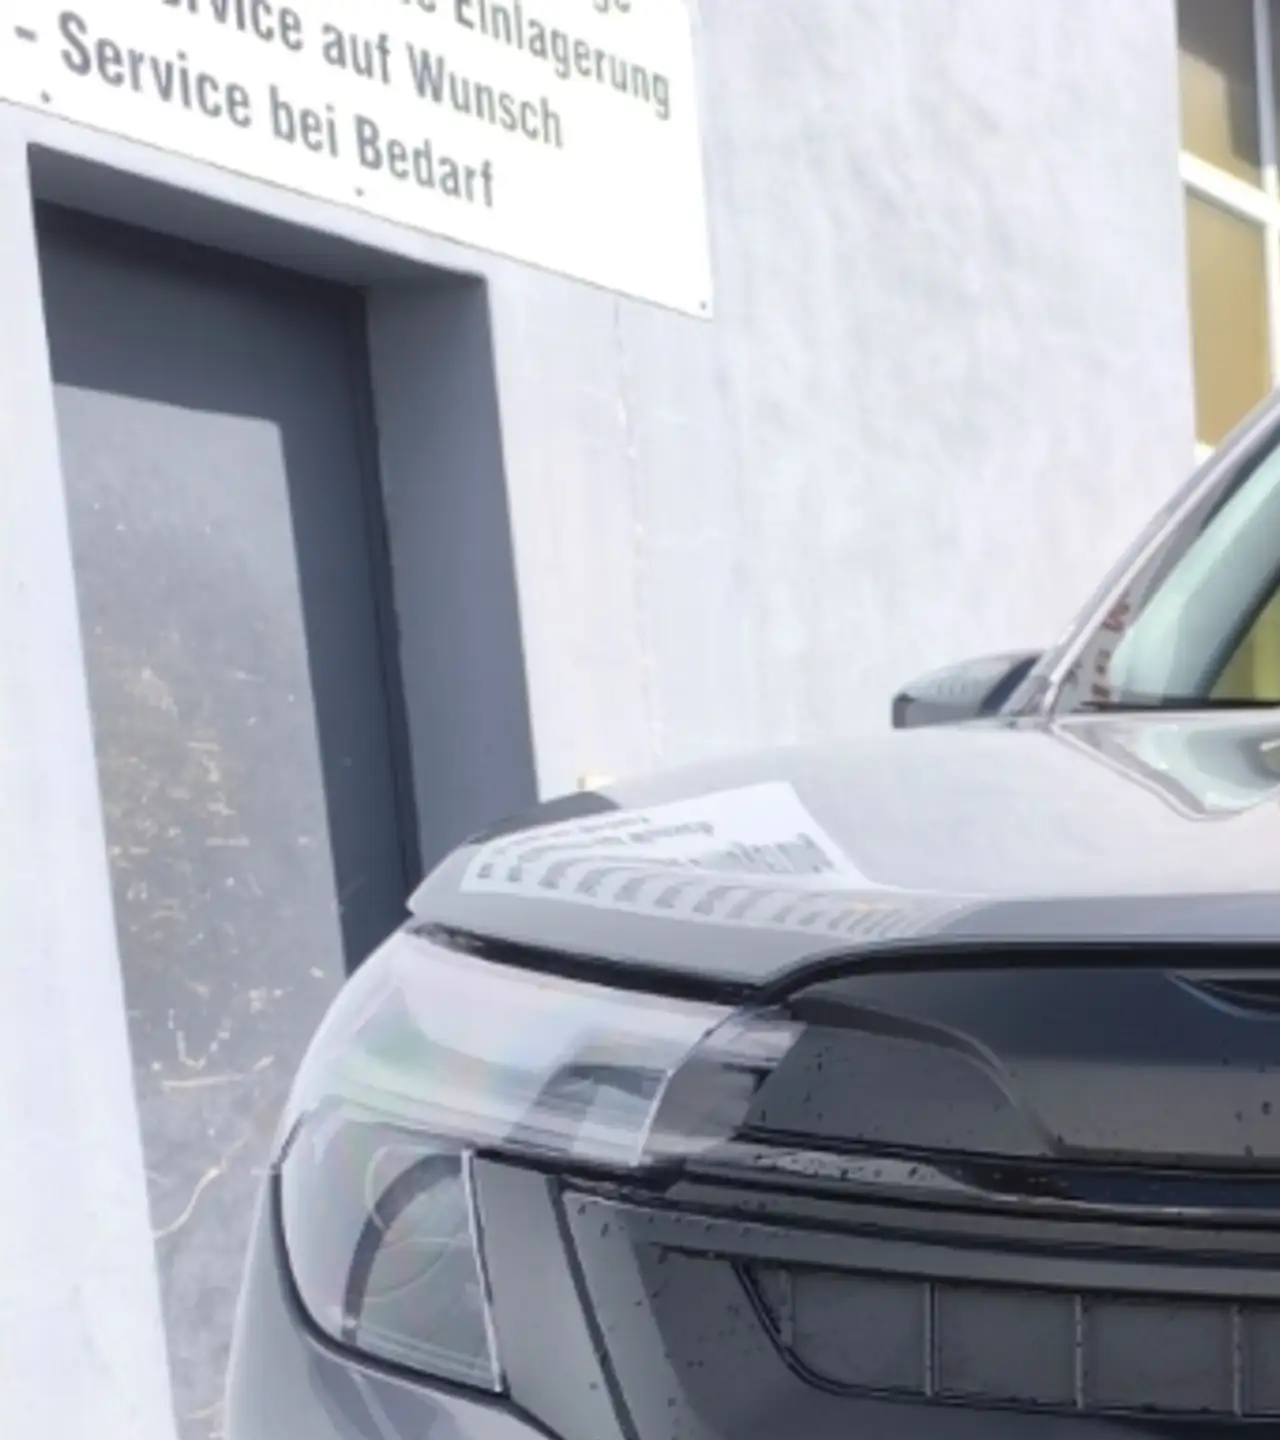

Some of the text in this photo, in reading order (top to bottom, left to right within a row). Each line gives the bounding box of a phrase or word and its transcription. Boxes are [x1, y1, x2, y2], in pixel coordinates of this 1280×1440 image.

[58, 10, 252, 129] Service
[268, 83, 339, 158] bei
[353, 112, 495, 208] Bedarf
[162, 0, 564, 150] vice auf Wunsch
